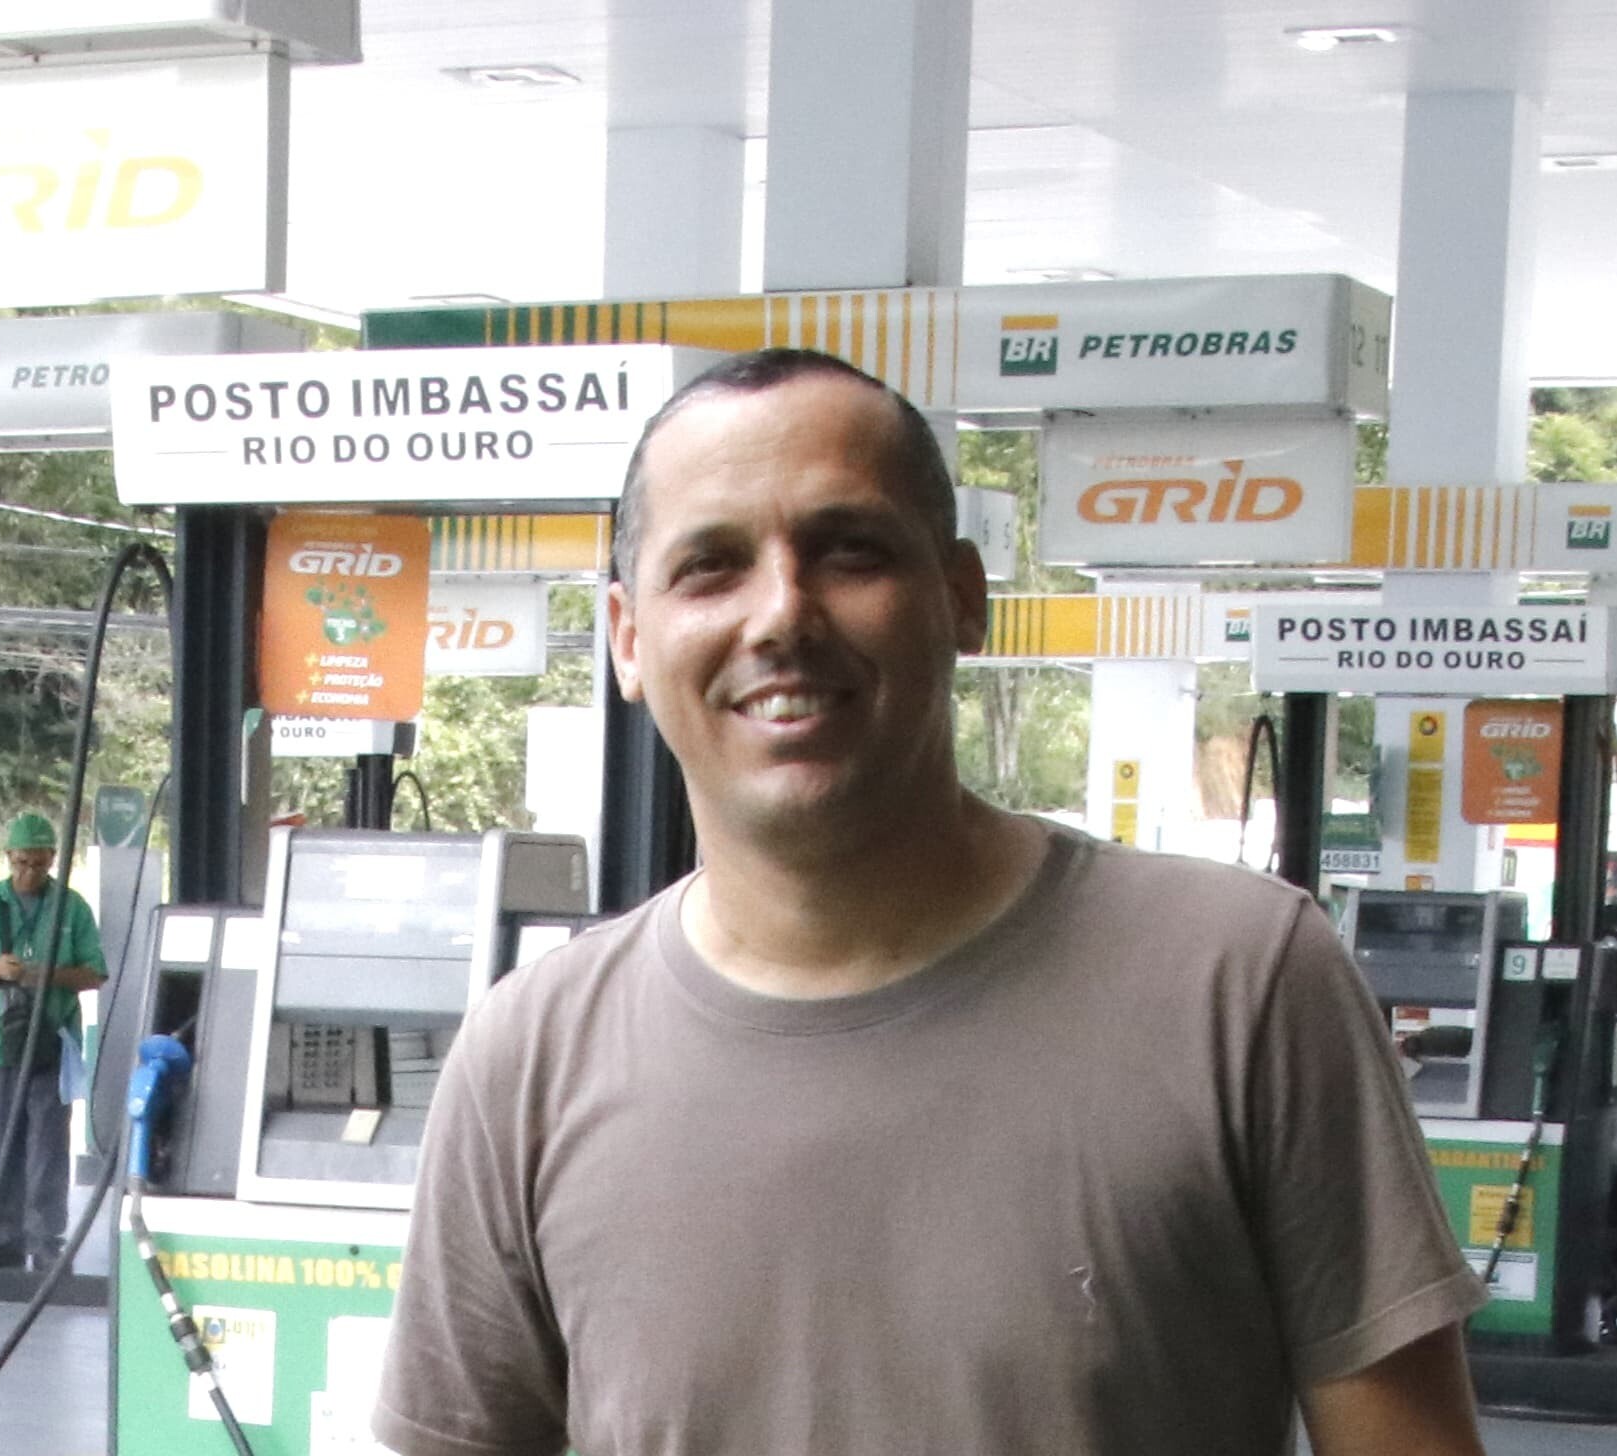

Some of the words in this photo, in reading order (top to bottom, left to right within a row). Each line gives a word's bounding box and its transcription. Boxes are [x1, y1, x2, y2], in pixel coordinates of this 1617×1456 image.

[1007, 334, 1053, 363] BR
[1079, 329, 1298, 359] PETROBRAS
[149, 379, 331, 422] POSTO
[351, 361, 630, 419] IMBASSAÍ
[242, 435, 316, 465] RIO
[333, 433, 392, 463] DO
[407, 429, 534, 462] OURO
[1076, 459, 1303, 525] GRID
[1571, 521, 1605, 540] BR
[289, 542, 403, 577] GRID
[426, 608, 515, 649] RID
[1278, 617, 1396, 643] POSTO
[1410, 612, 1588, 643] IMBASSAÍ
[1337, 651, 1385, 669] RIO
[1397, 651, 1435, 670] DO
[1444, 651, 1526, 670] OURO
[280, 727, 326, 738] OURO
[1512, 955, 1526, 975] 9
[301, 1256, 381, 1289] 100%
